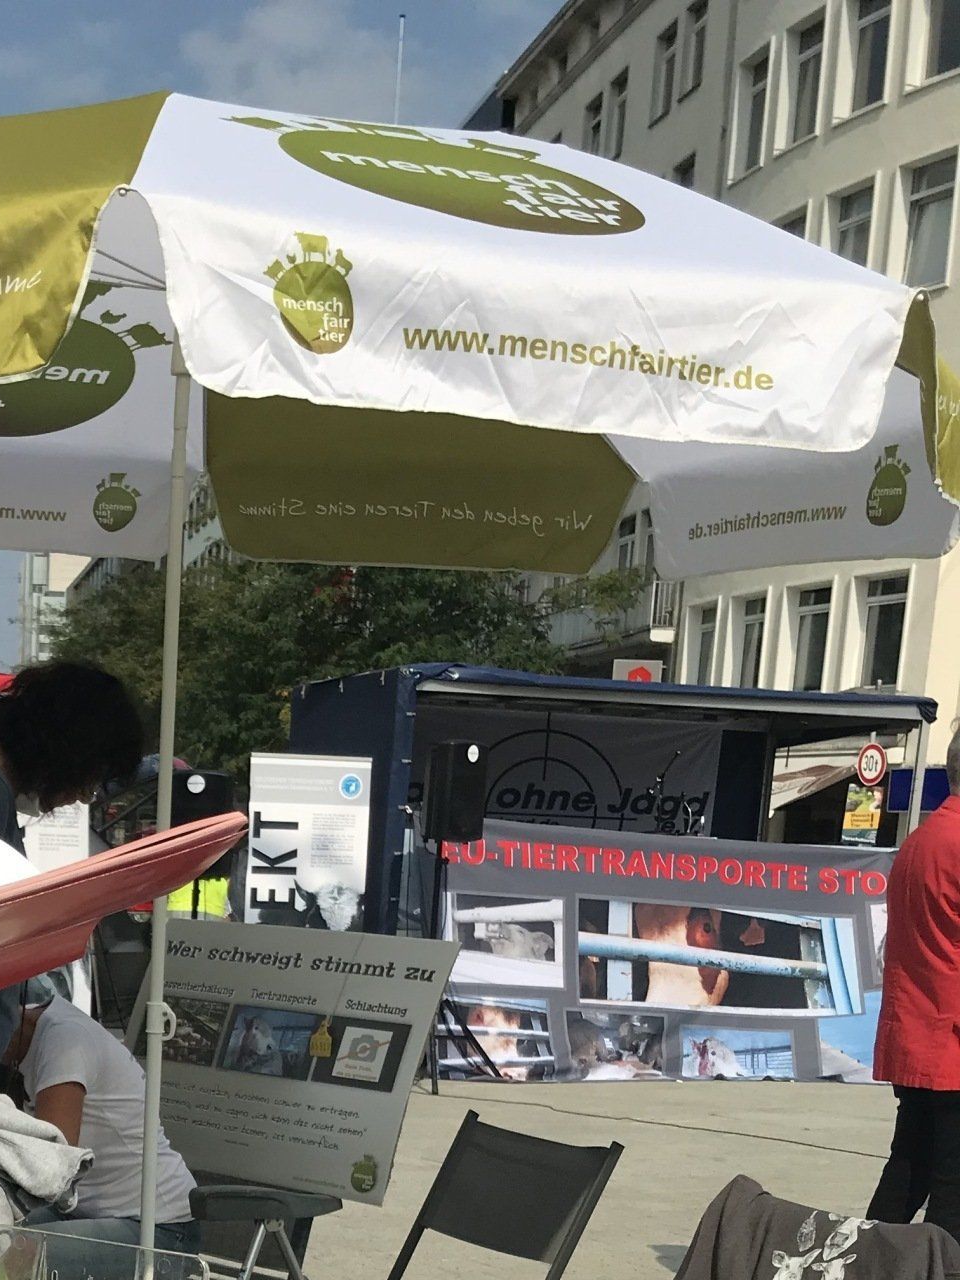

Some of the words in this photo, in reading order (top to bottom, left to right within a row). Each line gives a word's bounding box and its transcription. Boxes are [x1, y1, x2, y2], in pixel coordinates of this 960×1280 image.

[319, 150, 582, 197] mensch
[505, 184, 623, 212] fair
[503, 199, 622, 226] tier
[282, 296, 343, 316] mensch
[318, 326, 346, 344] tier
[322, 313, 350, 330] fair
[402, 326, 774, 391] www.menschfairtier.de
[496, 781, 590, 812] ohne
[606, 787, 709, 821] Jagd
[441, 838, 809, 893] EU-TIERTRANSPORTE
[167, 940, 202, 958] Wer
[208, 946, 303, 970] schweigt
[310, 955, 395, 979] stimmt
[405, 966, 436, 983] zu
[164, 980, 234, 997] assentierhaltung
[345, 999, 408, 1017] Schlachtung
